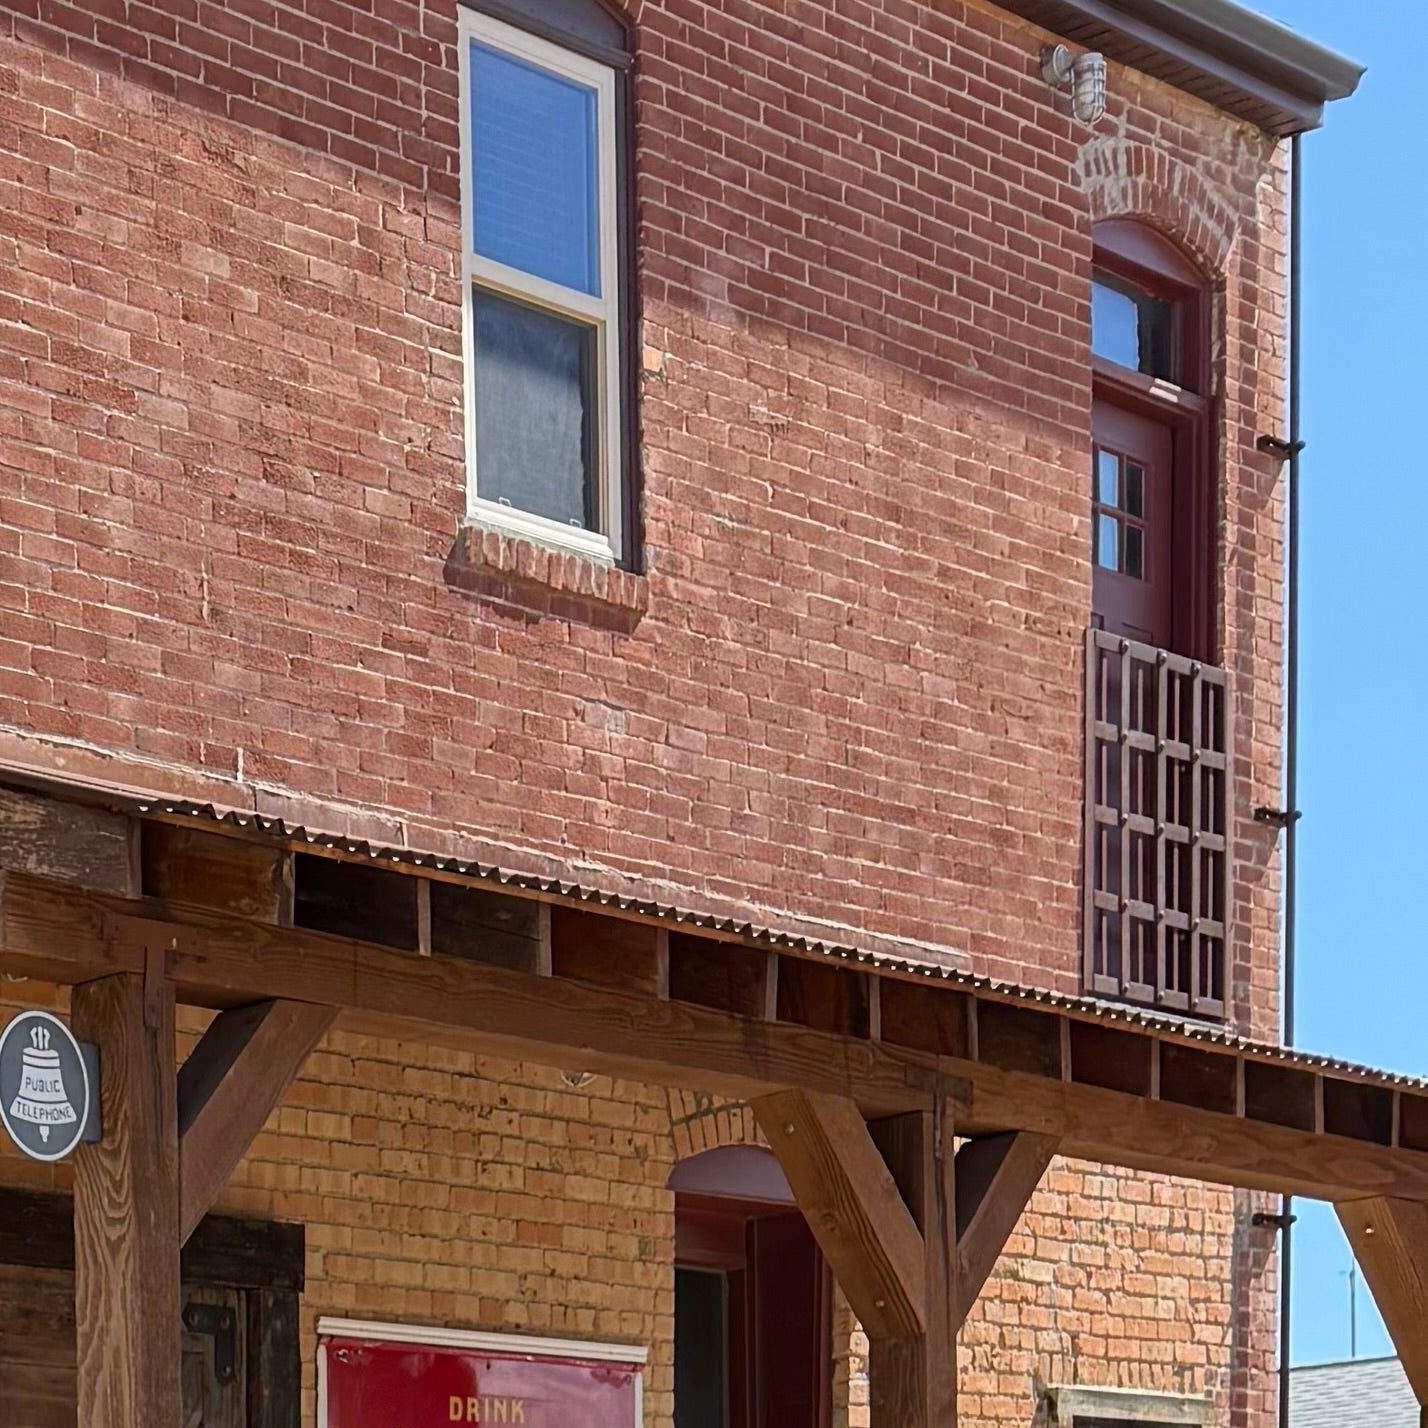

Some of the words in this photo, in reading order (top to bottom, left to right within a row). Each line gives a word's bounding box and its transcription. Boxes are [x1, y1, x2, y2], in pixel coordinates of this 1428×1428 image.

[25, 1076, 60, 1094] PUBLIC
[16, 1100, 72, 1120] TELEPHONE
[449, 1395, 525, 1424] DRINK
